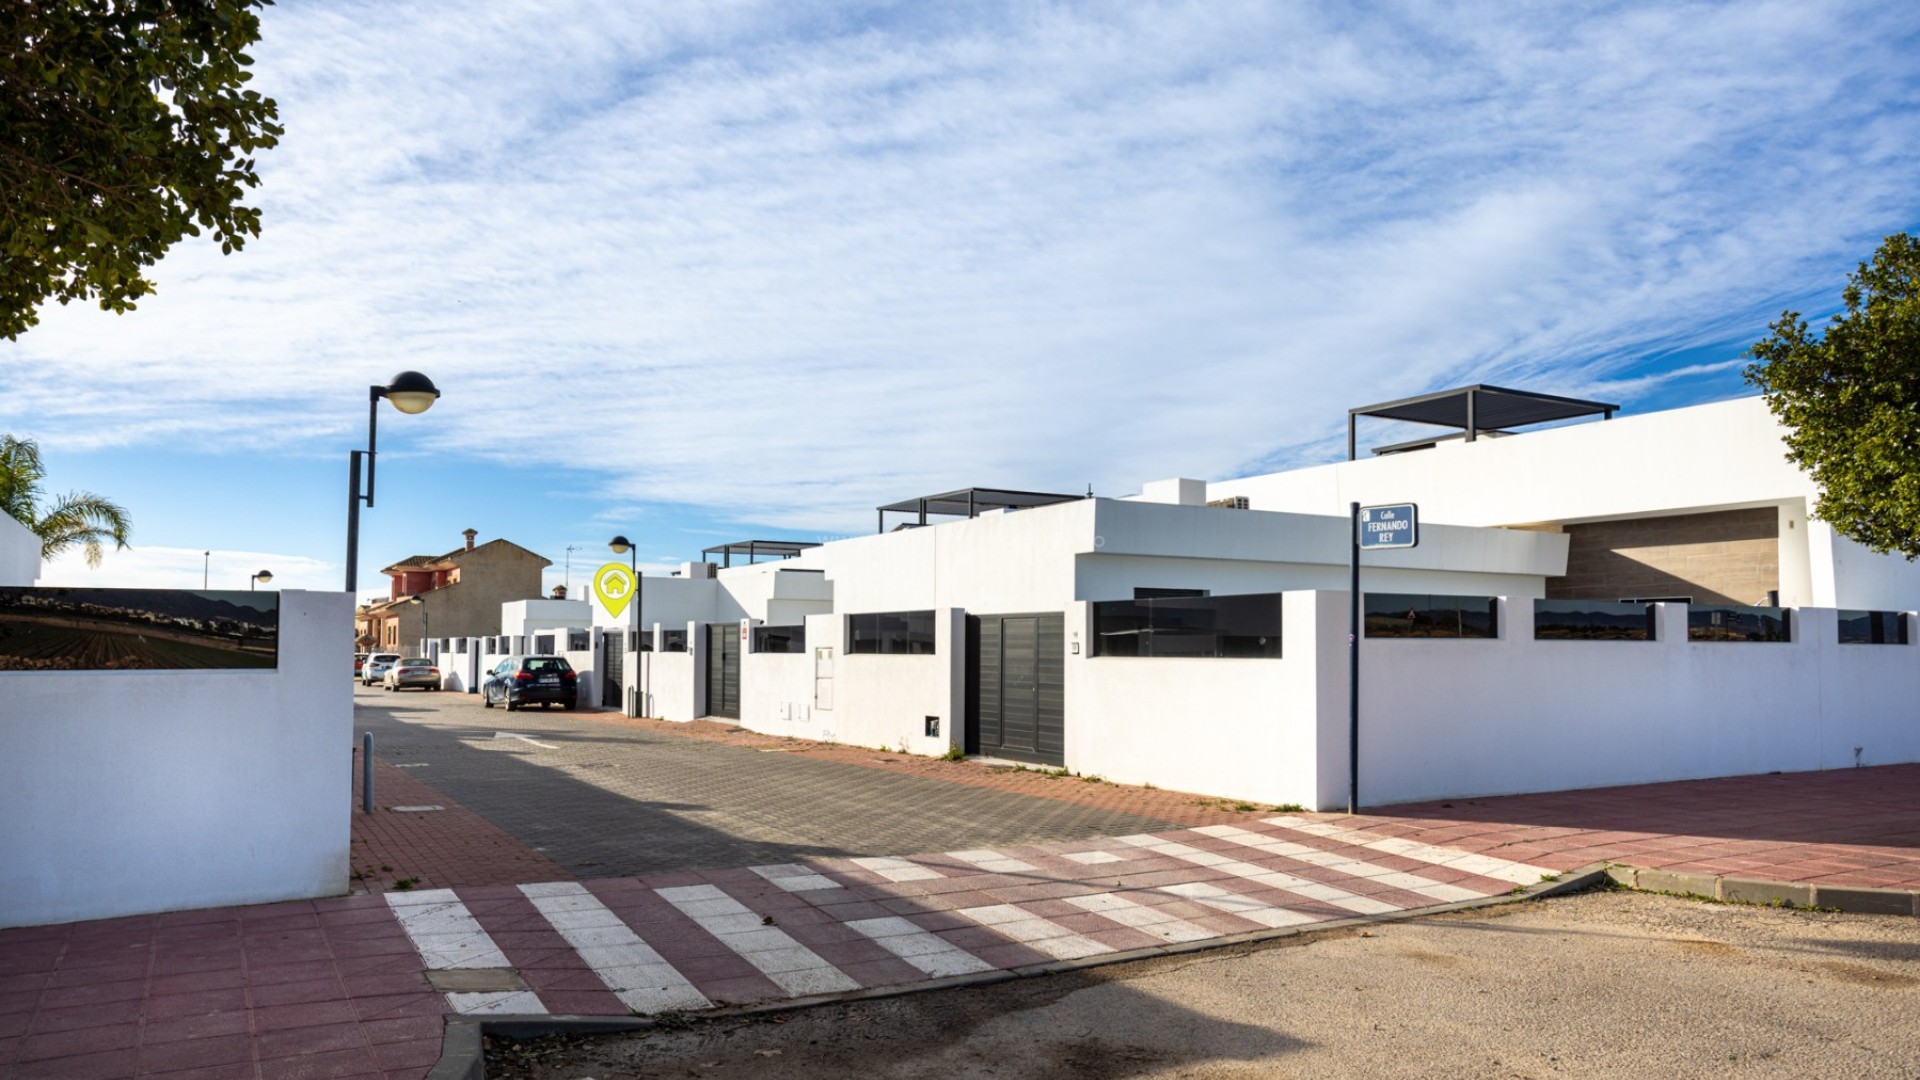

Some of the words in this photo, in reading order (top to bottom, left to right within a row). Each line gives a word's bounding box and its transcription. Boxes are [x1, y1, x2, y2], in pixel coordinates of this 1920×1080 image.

[1380, 510, 1395, 520] Calle
[1368, 520, 1409, 532] FERNANDO
[1379, 532, 1394, 543] REY
